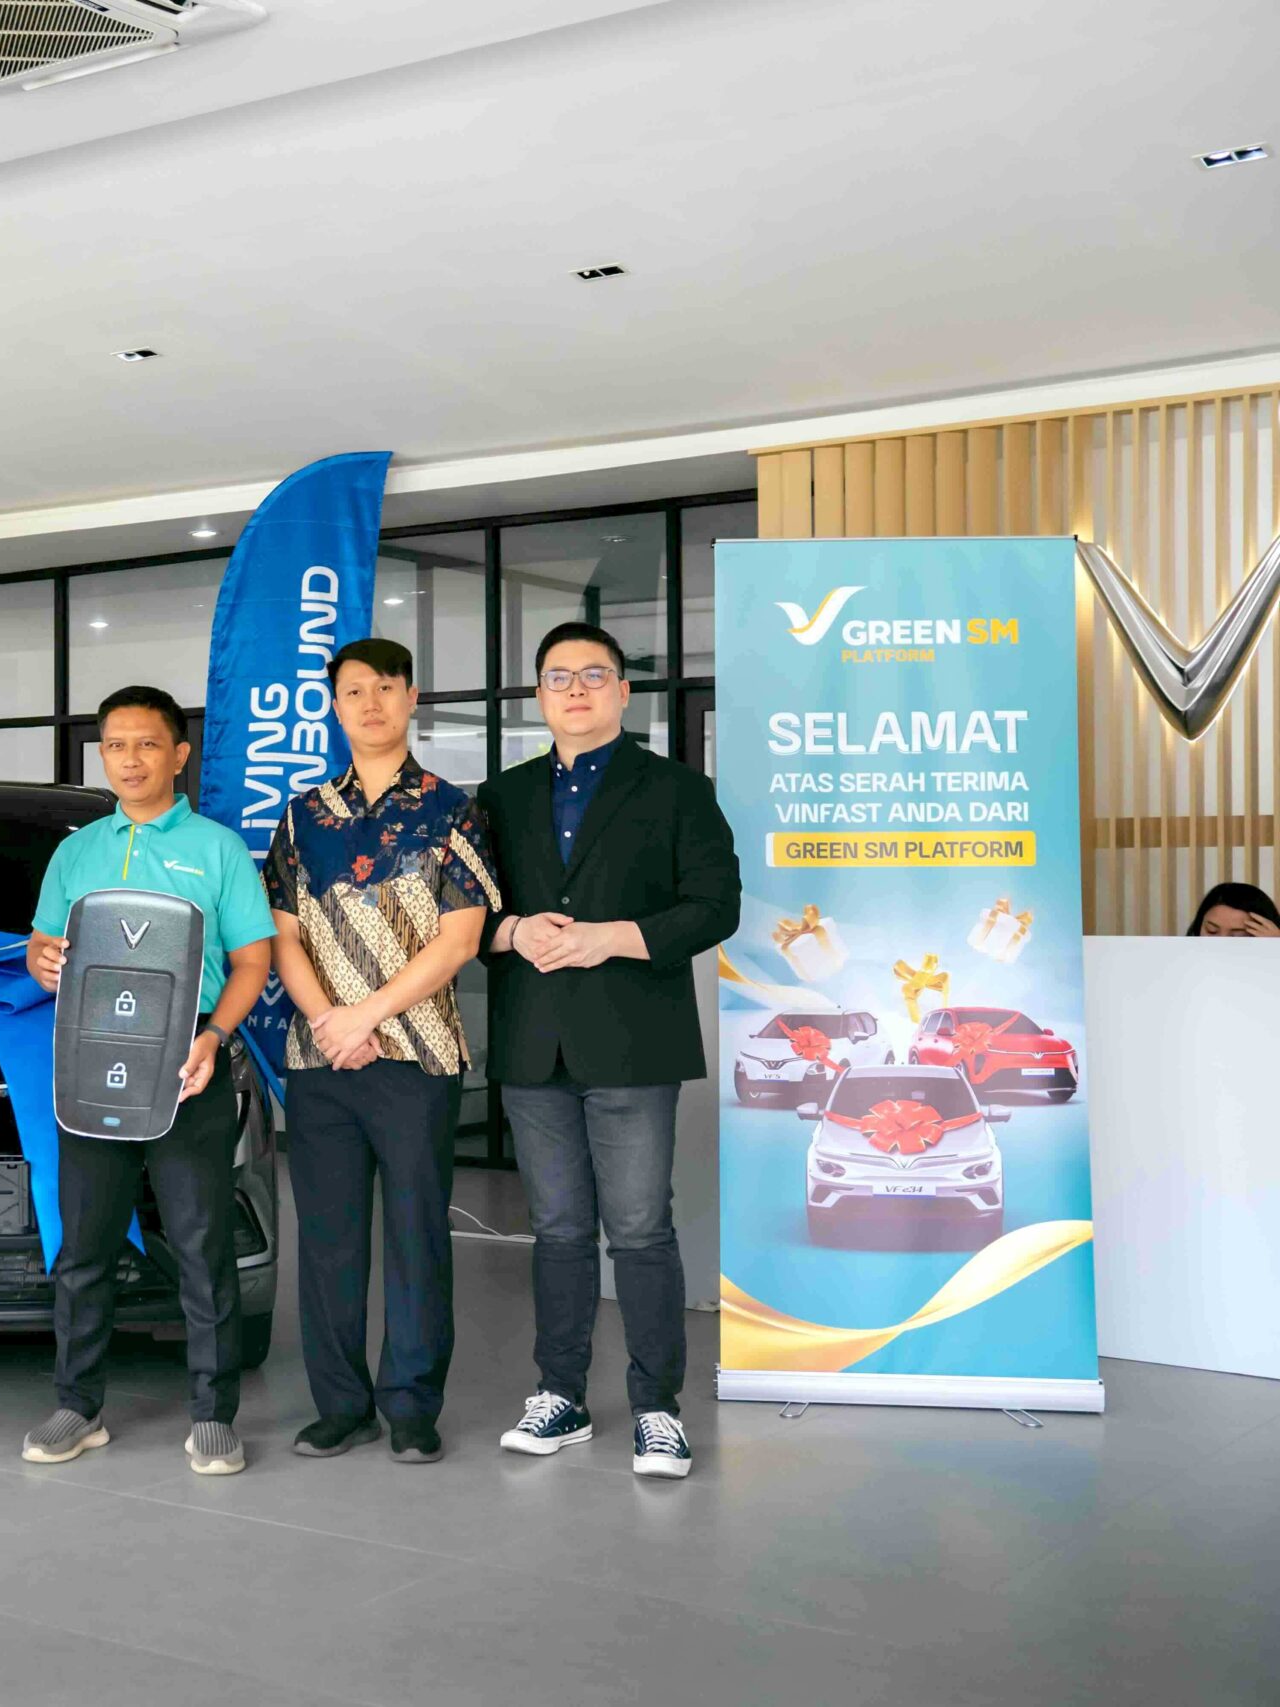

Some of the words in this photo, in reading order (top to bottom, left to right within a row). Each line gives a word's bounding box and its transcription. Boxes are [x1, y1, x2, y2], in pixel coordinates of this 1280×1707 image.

[842, 619, 961, 646] GREEN
[967, 618, 1019, 644] SM
[841, 648, 935, 662] PLATFORM
[288, 565, 339, 801] NBOUND
[767, 710, 1029, 755] SELAMAT
[770, 772, 834, 793] ATAS
[839, 772, 925, 793] SERAH
[930, 771, 1030, 792] TERIMA
[775, 803, 882, 824] VINFAST
[888, 803, 963, 823] ANDA
[969, 802, 1029, 822] DARI
[785, 842, 858, 859] GREEN
[864, 842, 898, 859] SM
[904, 841, 1023, 858] PLATFORM
